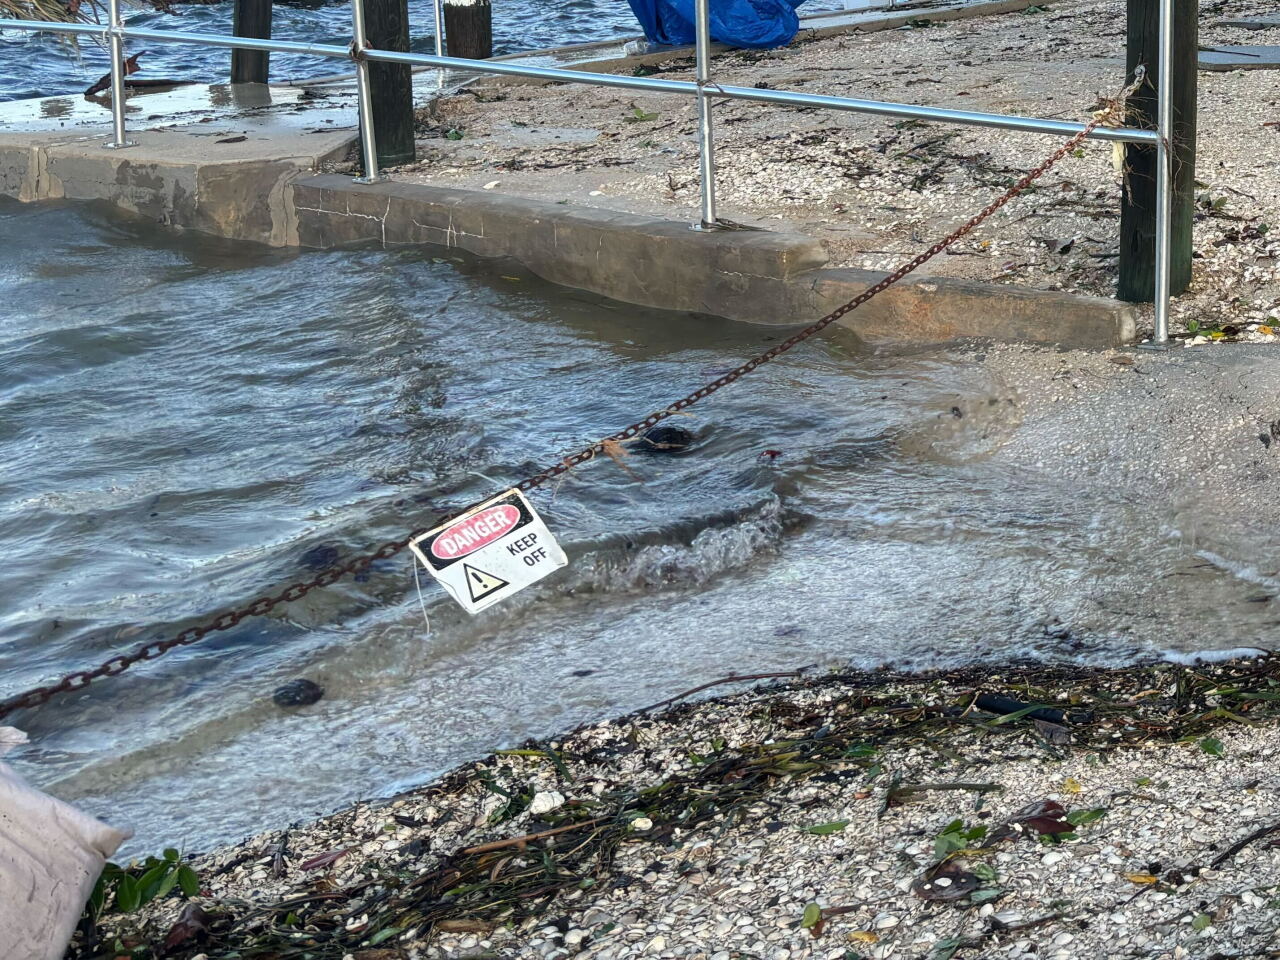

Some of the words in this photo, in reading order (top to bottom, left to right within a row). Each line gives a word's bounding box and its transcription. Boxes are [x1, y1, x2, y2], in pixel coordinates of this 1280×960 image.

[441, 510, 512, 555] DANGER
[506, 532, 538, 557] KEEP
[523, 546, 548, 567] OFF
